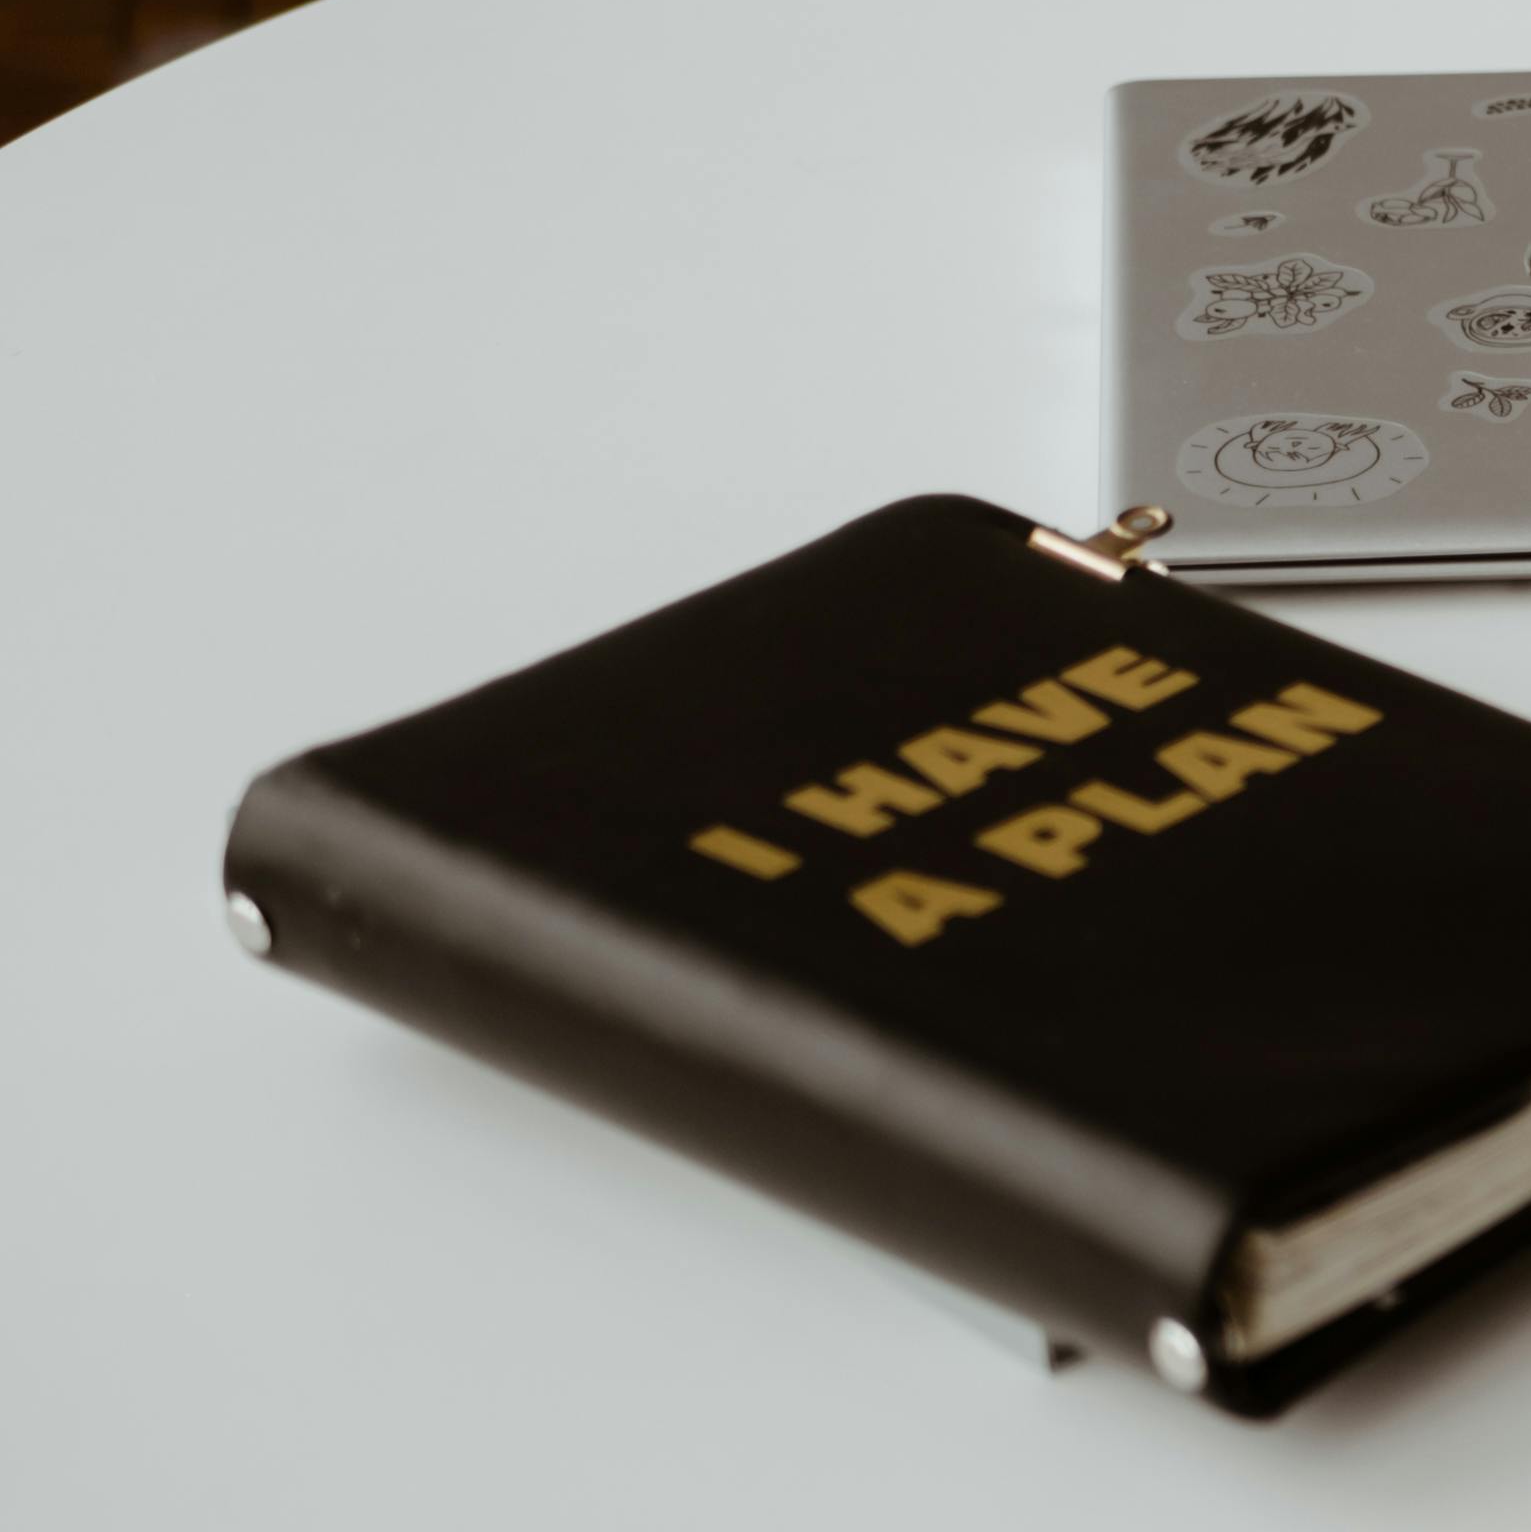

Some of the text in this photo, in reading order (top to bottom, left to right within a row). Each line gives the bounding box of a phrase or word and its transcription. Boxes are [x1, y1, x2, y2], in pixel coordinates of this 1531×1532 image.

[687, 645, 1200, 880] I HAVE
[848, 681, 1385, 948] A PLAN
